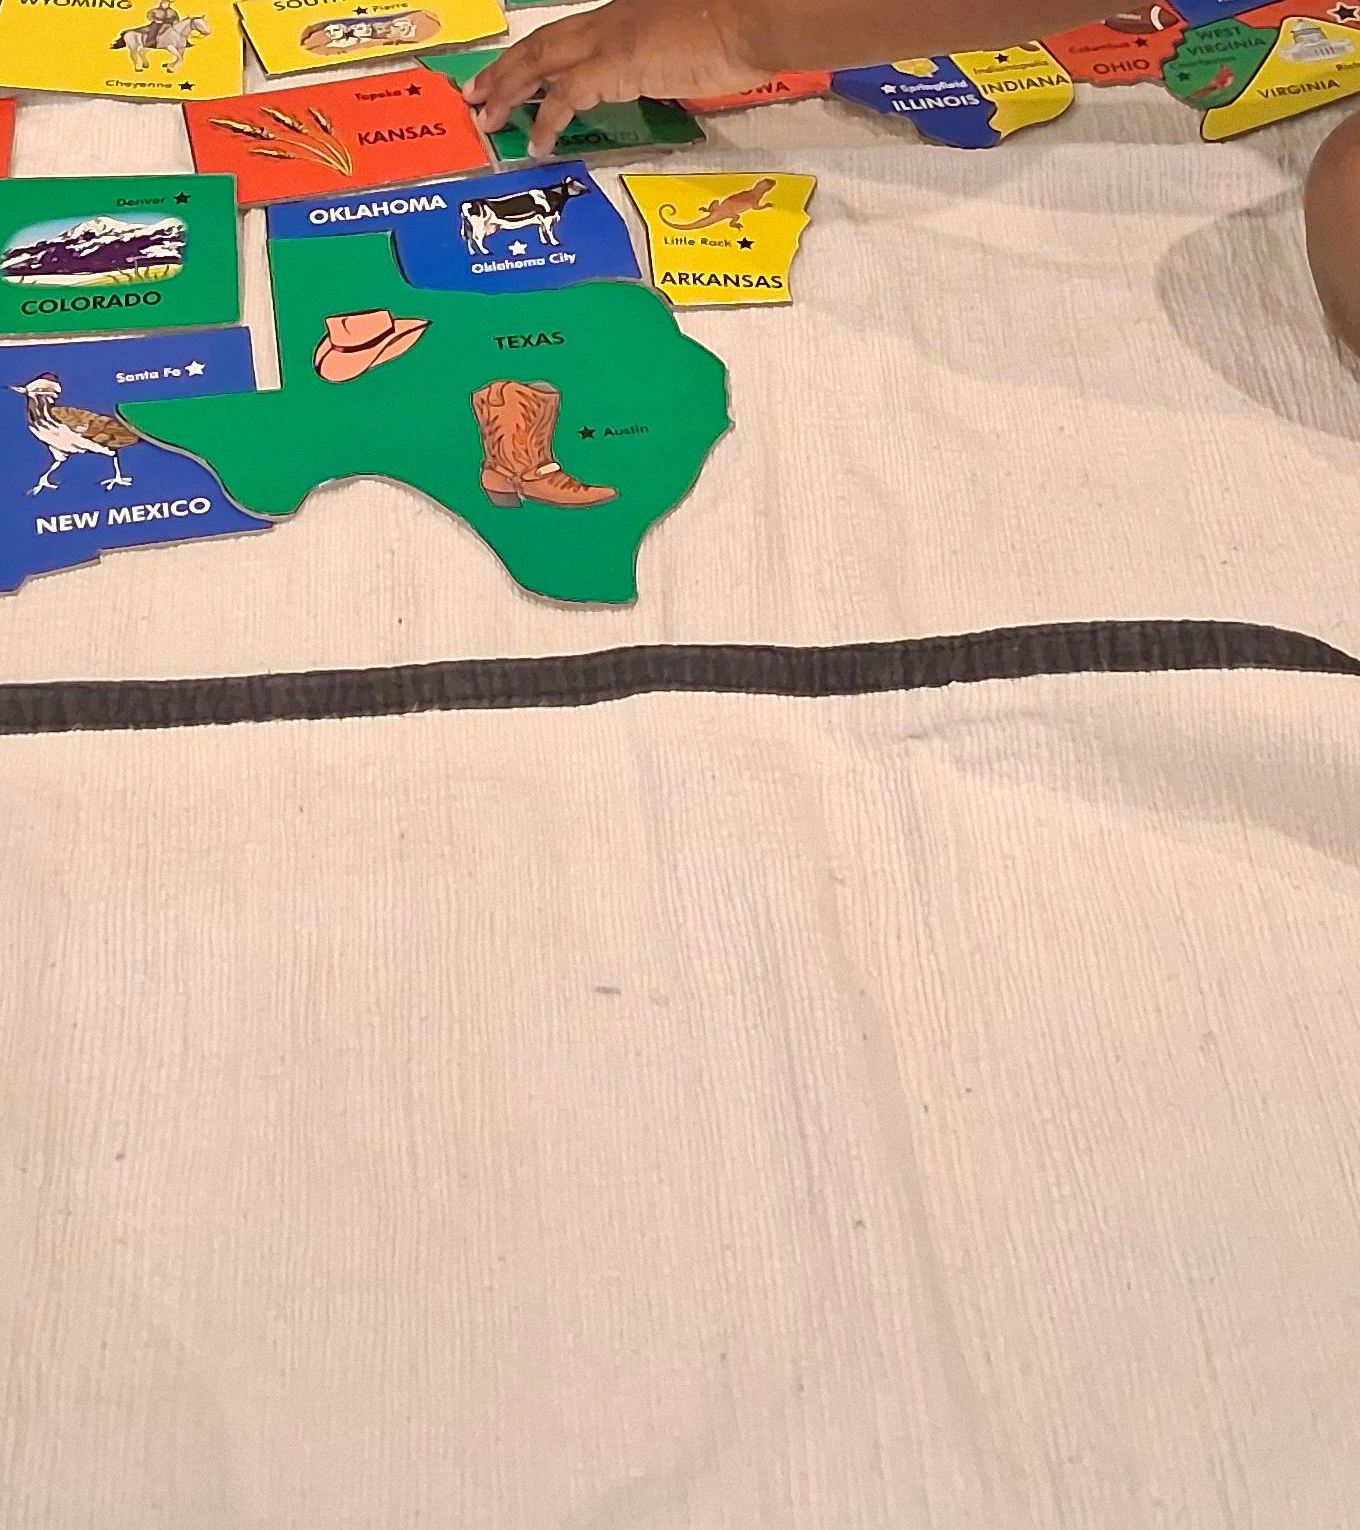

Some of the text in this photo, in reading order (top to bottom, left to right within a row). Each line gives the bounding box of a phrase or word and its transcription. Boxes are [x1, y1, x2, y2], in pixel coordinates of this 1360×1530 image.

[1194, 26, 1241, 41] WEST
[1187, 37, 1266, 57] VIRGINIA
[1093, 58, 1151, 75] OHIO
[105, 79, 173, 89] Cheyenne
[899, 79, 969, 94] Springfield
[981, 74, 1070, 96] INDIANA
[1256, 78, 1340, 99] VIRGINIA
[354, 88, 402, 101] Topeka
[891, 93, 981, 112] ILLINOIS
[357, 121, 447, 146] KANSAS
[116, 196, 165, 208] Denver
[308, 192, 448, 226] OKLAHOMA
[663, 237, 733, 248] Little Rock
[471, 252, 577, 274] Oklahoma City
[660, 271, 784, 290] ARKANSAS
[20, 291, 162, 316] COLORADO
[493, 331, 566, 351] TEXAS
[116, 368, 181, 384] Santa Fe
[603, 424, 650, 438] Austin
[35, 497, 212, 536] NEW MEXICO
